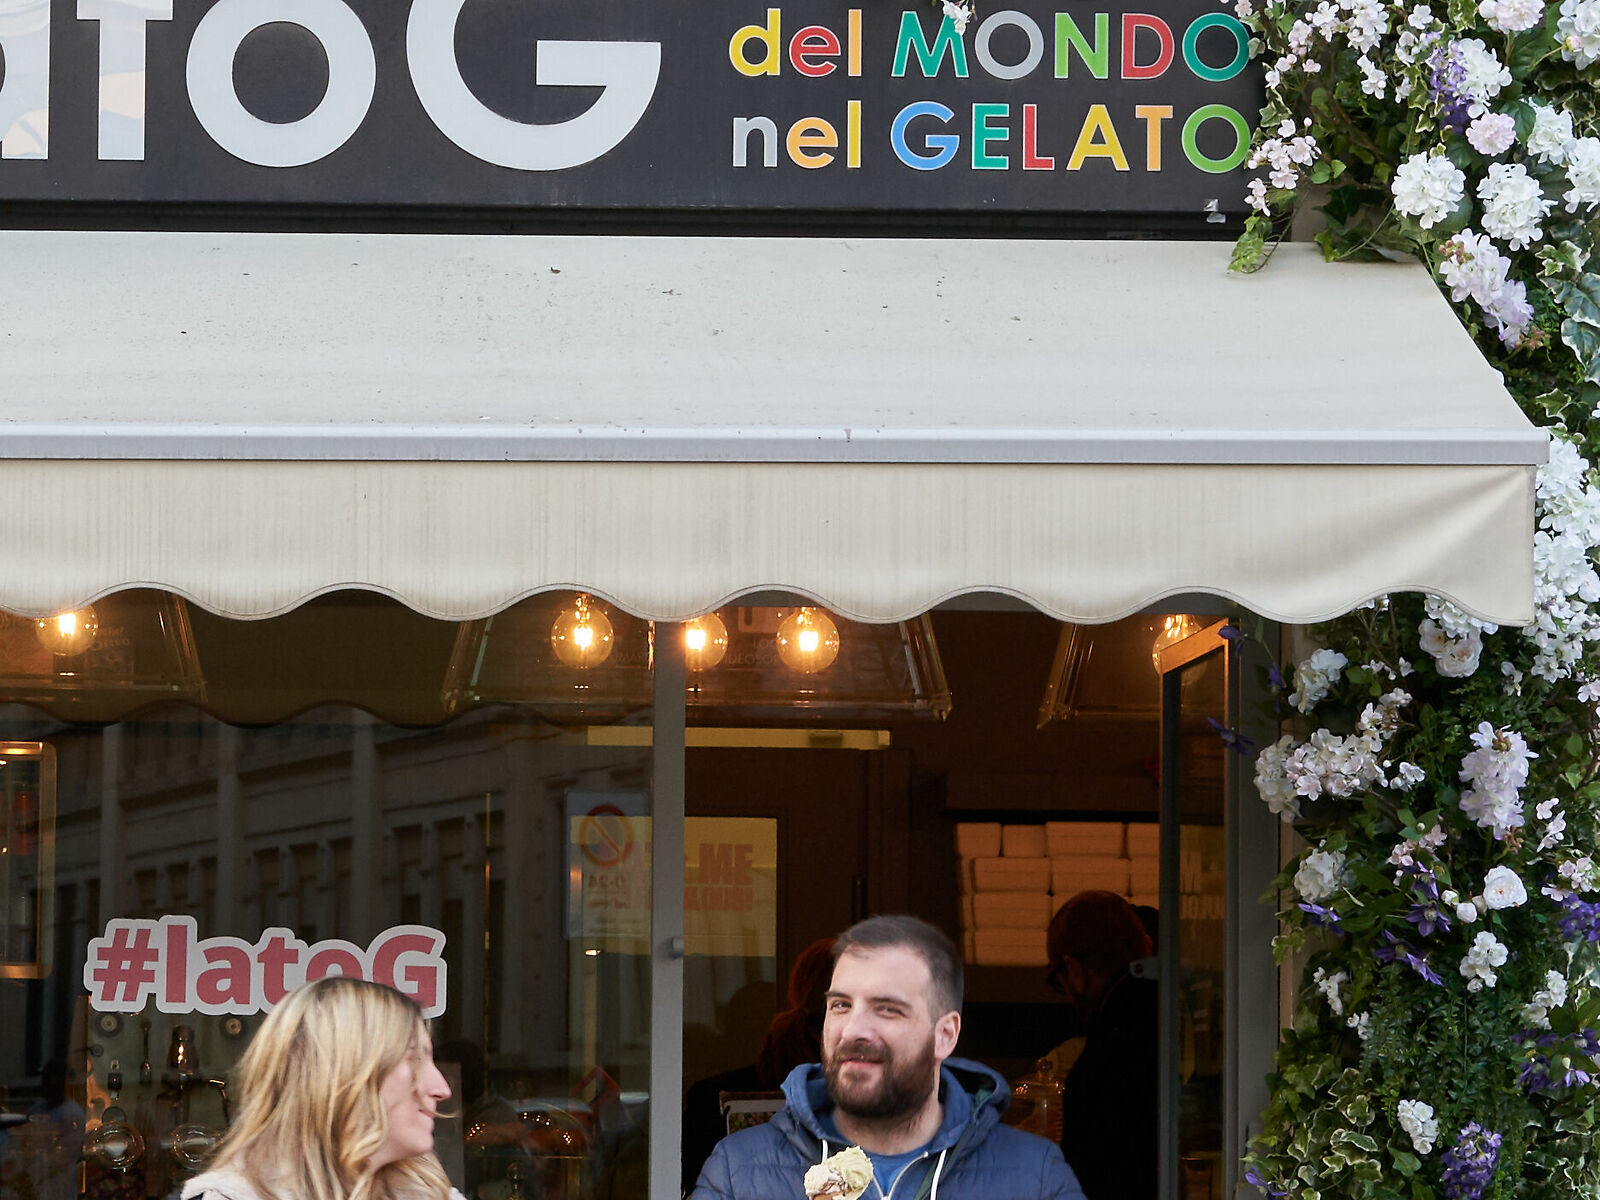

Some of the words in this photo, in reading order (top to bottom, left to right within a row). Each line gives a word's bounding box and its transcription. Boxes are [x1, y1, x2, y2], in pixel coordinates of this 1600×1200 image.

[728, 7, 863, 78] del
[890, 10, 1251, 82] MONDO
[0, 0, 662, 171] toG
[732, 99, 862, 169] nel
[890, 101, 1251, 174] GELATO
